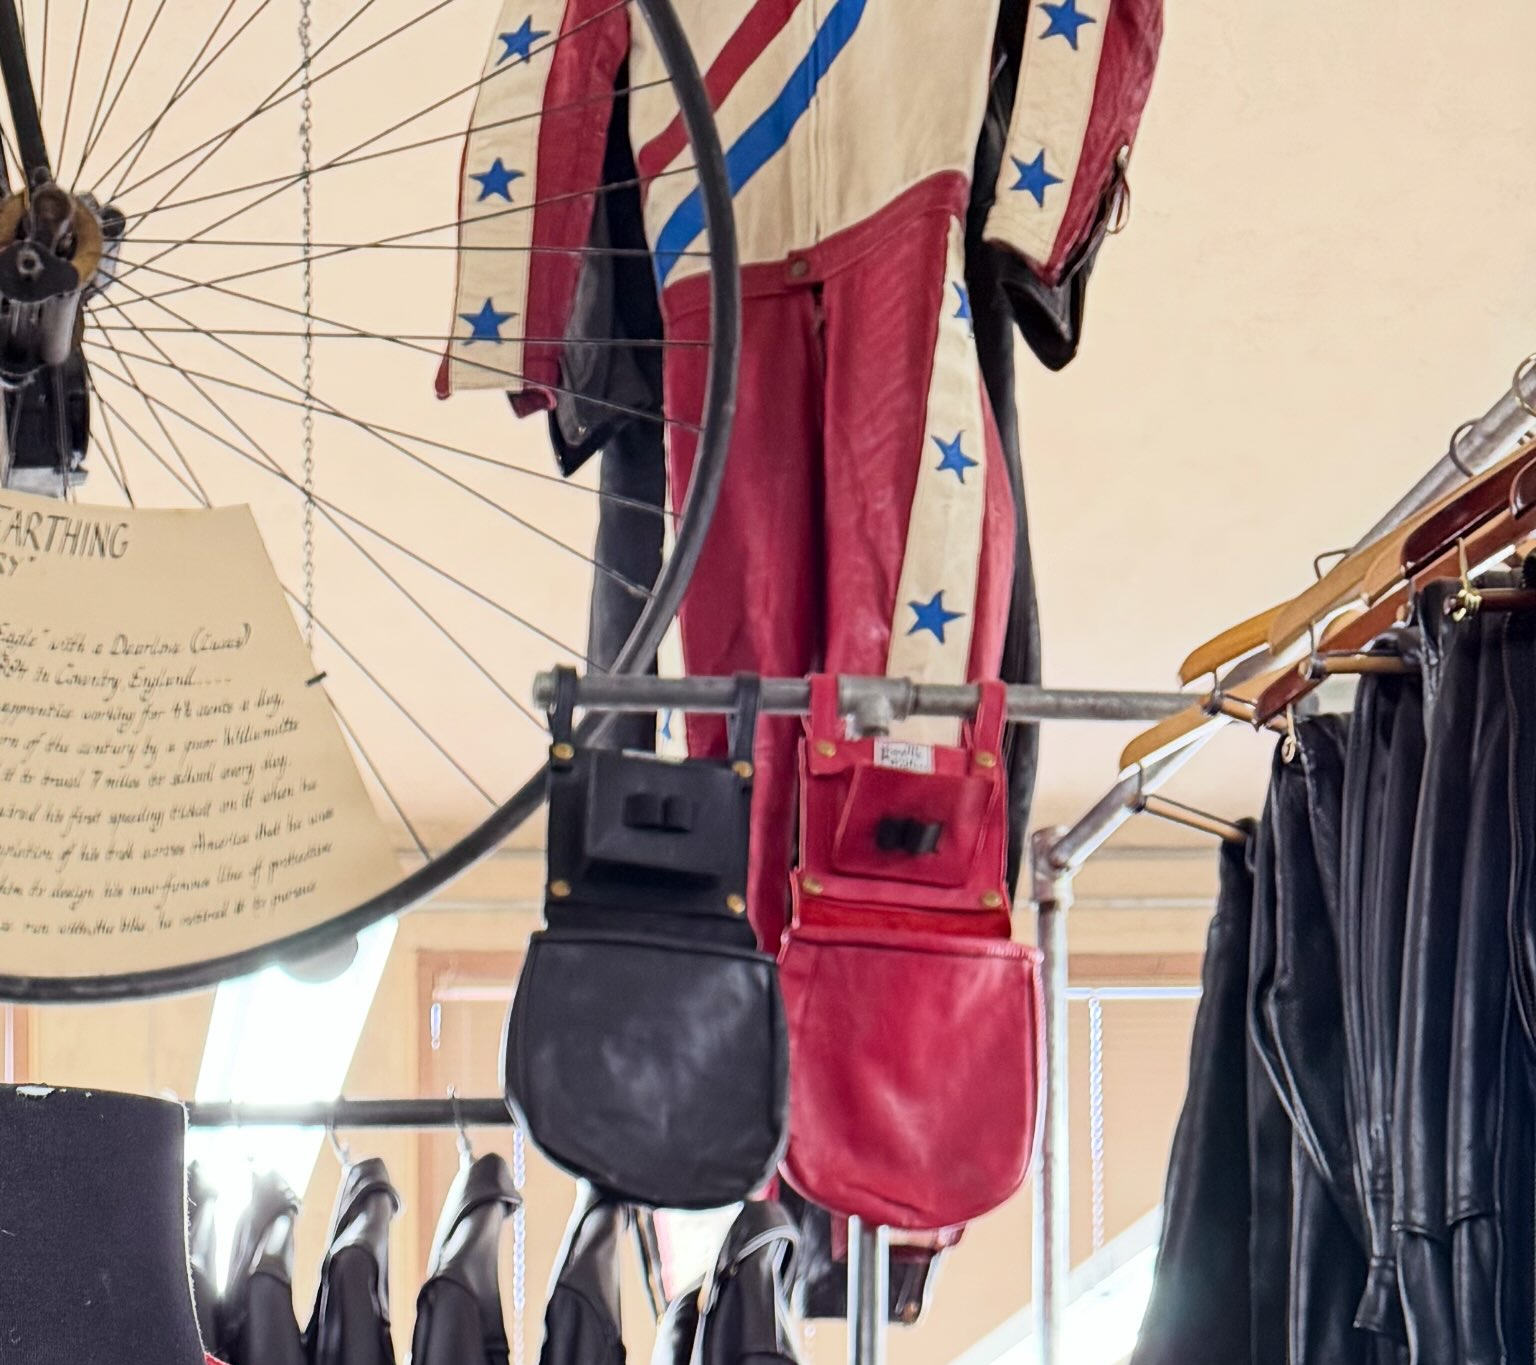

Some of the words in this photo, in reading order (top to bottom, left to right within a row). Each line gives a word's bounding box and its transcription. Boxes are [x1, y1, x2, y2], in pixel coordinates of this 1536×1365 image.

[48, 632, 87, 655] with
[91, 641, 104, 656] a
[32, 666, 50, 682] in
[44, 732, 70, 754] the
[91, 768, 104, 793] 7
[43, 800, 65, 824] his
